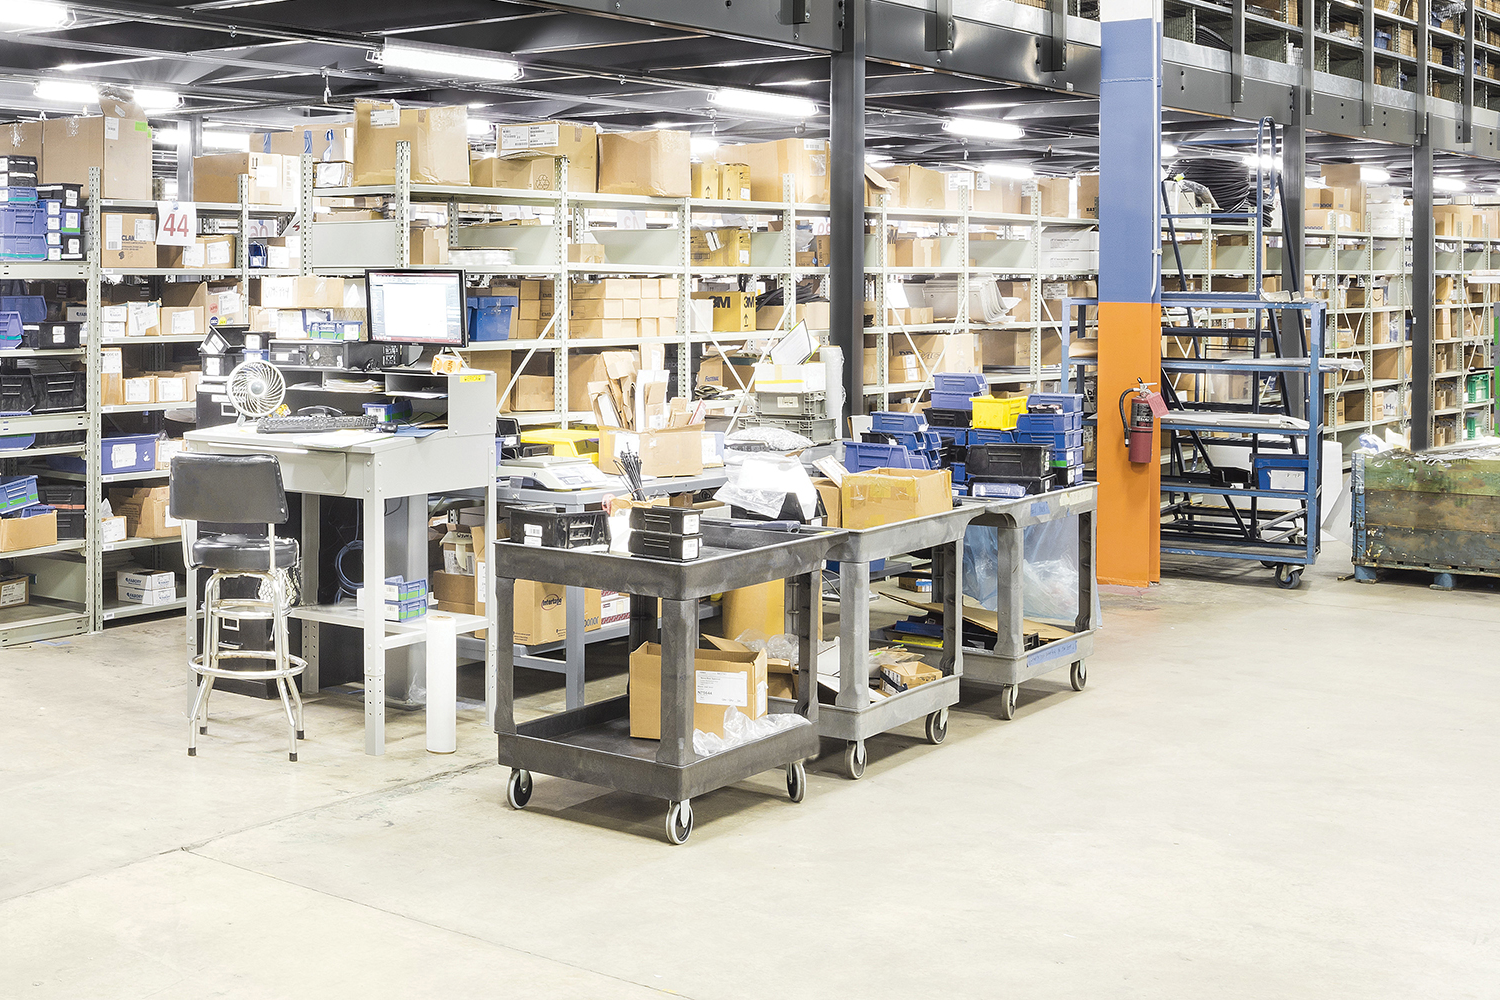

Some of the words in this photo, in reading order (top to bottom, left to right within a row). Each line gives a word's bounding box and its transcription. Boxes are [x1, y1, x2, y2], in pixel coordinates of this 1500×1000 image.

[163, 213, 189, 237] 44
[709, 296, 730, 308] 3M
[744, 296, 754, 308] 3M
